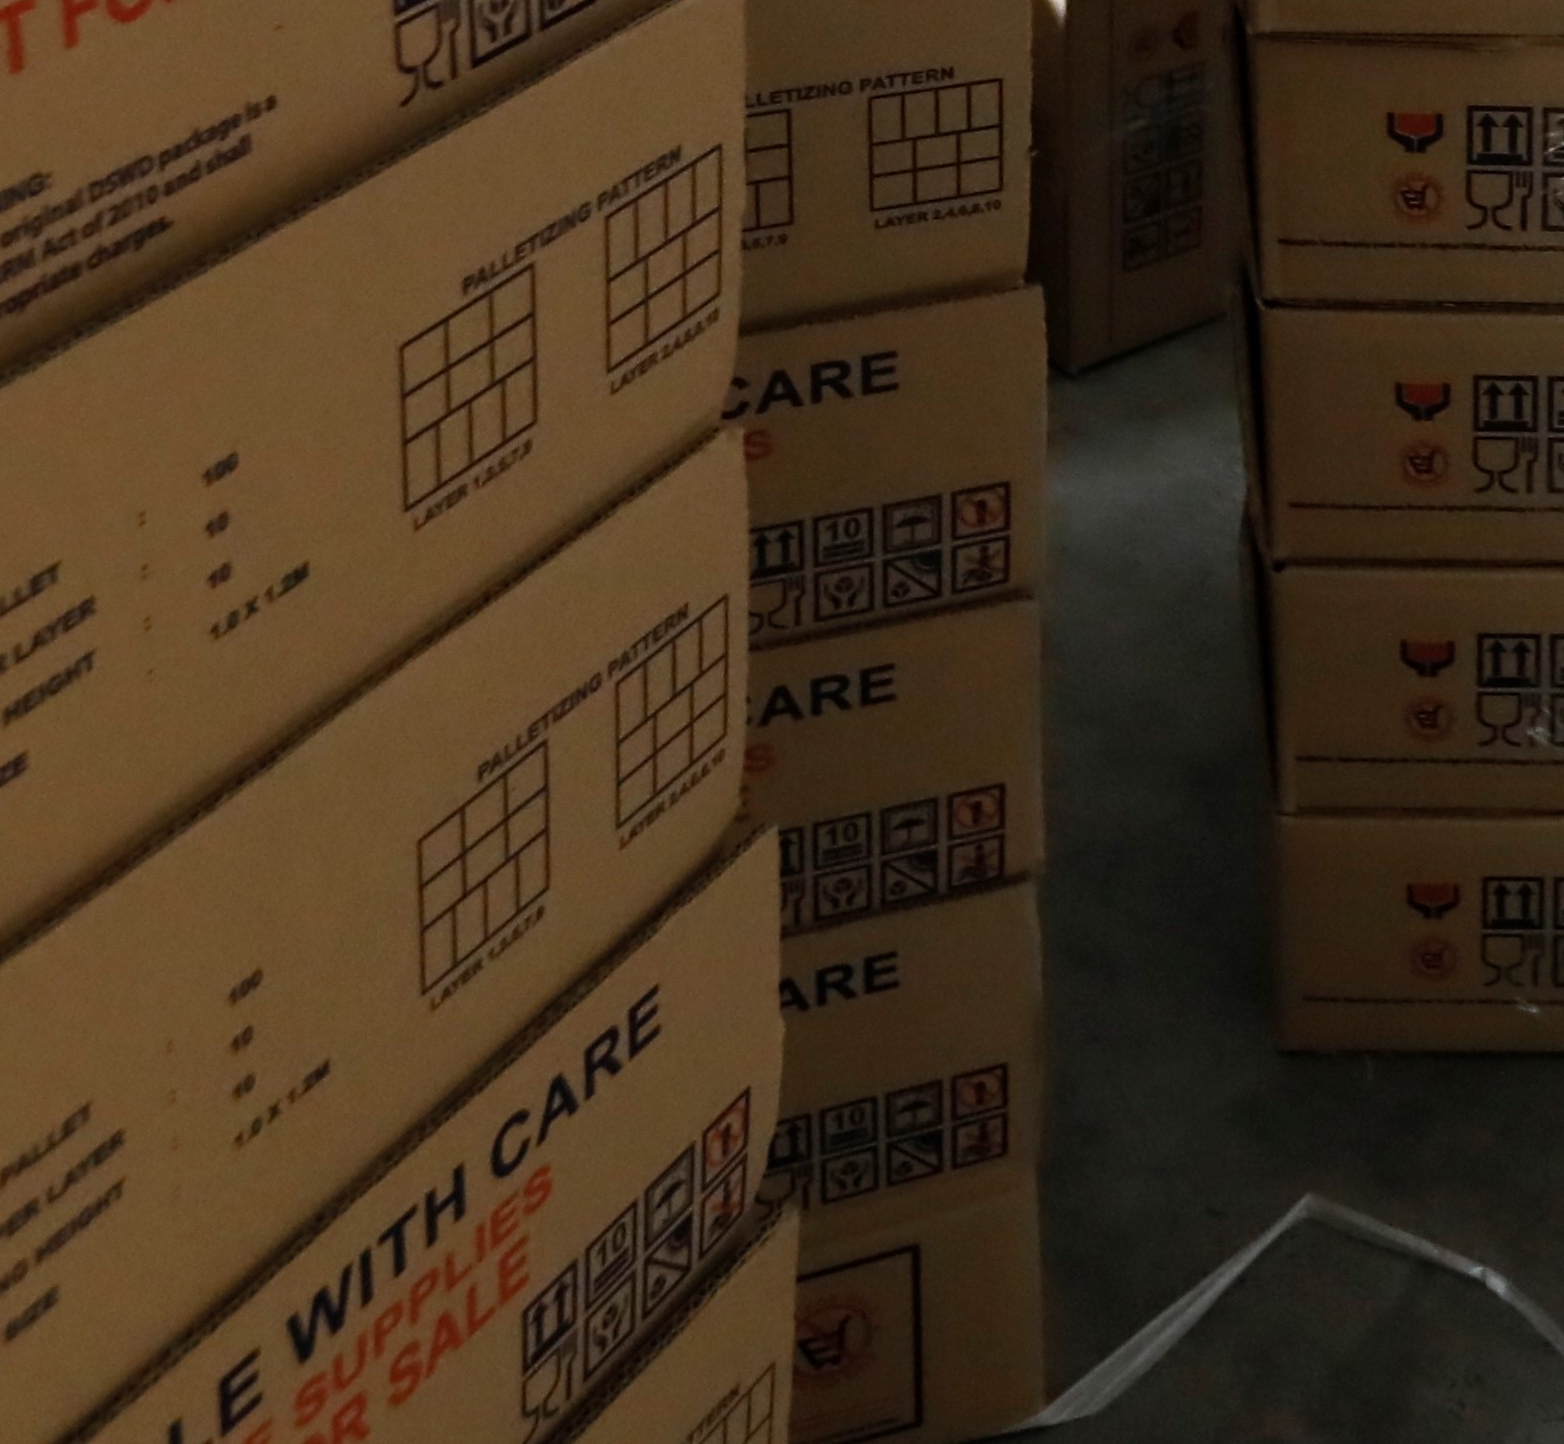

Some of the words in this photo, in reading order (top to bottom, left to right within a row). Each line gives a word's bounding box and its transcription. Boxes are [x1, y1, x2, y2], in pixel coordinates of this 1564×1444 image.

[744, 82, 854, 109] LLETIZING
[859, 66, 956, 95] PATTERN
[0, 186, 82, 254] original
[88, 150, 154, 205] DSWD
[159, 106, 242, 173] package
[246, 96, 260, 122] is
[82, 210, 103, 241] of
[163, 159, 201, 199] and
[206, 132, 251, 175] shall
[461, 202, 593, 298] PALLETIZING
[597, 145, 682, 212] PATTERN
[874, 211, 929, 232] LAYER
[13, 595, 98, 666] LAYER
[3, 648, 98, 729] HEIGHT
[476, 672, 603, 785] PALLETIZING
[607, 603, 690, 681] PATTERN
[746, 662, 898, 730] ARE
[779, 950, 901, 1012] ARE
[0, 1101, 94, 1188] PALLET
[43, 1129, 126, 1205] LAYER
[287, 1161, 468, 1364] WITH
[490, 983, 664, 1179] CARE
[35, 1178, 126, 1268] HEIGHT
[5, 1286, 61, 1342] SIZE
[294, 1163, 554, 1428] SUPPLIES
[387, 1236, 532, 1408] SALE
